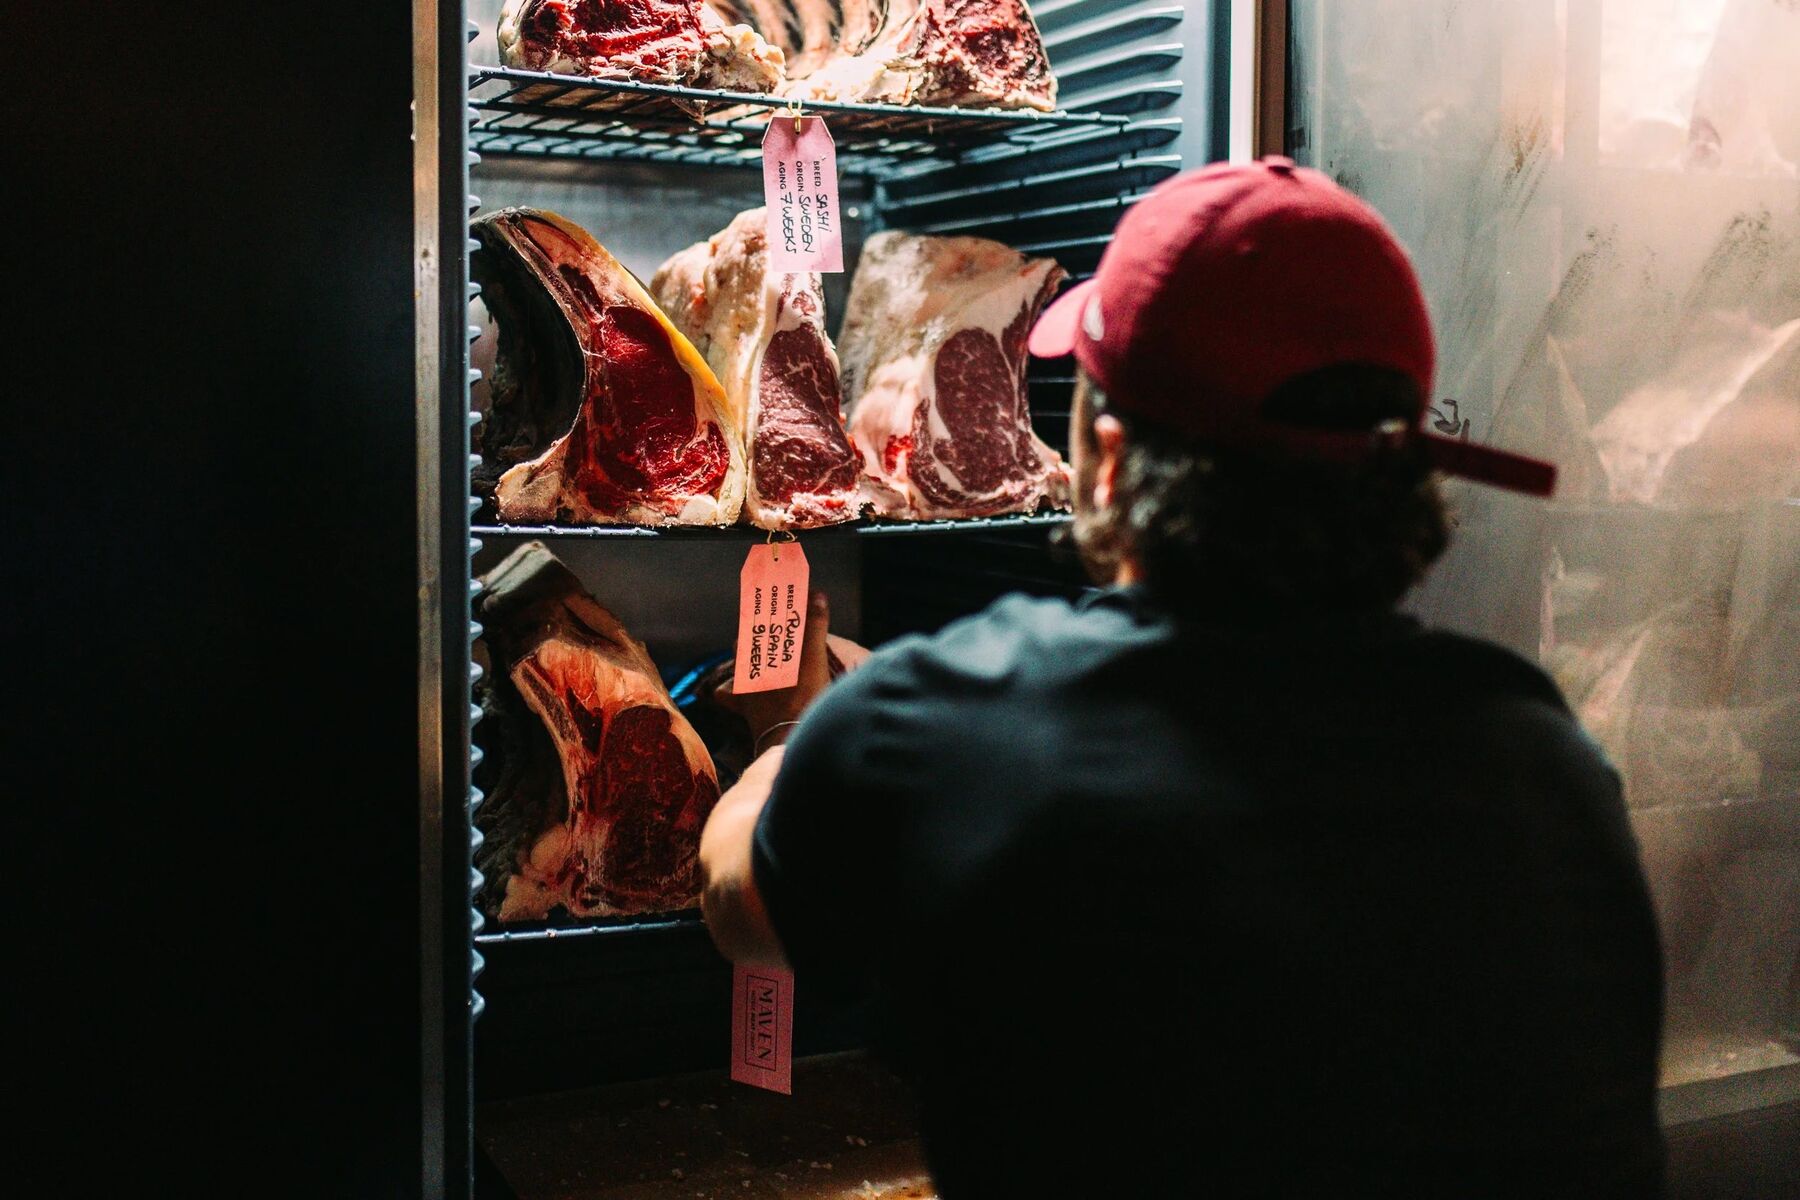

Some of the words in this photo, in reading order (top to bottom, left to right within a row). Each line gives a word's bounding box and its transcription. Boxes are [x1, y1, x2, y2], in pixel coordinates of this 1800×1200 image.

[778, 160, 787, 190] AGING
[795, 160, 804, 192] ORIGIN
[813, 160, 822, 187] BREED
[780, 191, 793, 205] 7
[782, 206, 797, 254] WEEKS
[799, 194, 815, 253] SWEDEN
[754, 587, 762, 615] AGING
[770, 585, 778, 616] ORIGIN
[786, 584, 795, 610] BREED
[758, 986, 773, 1060] MAVEN
